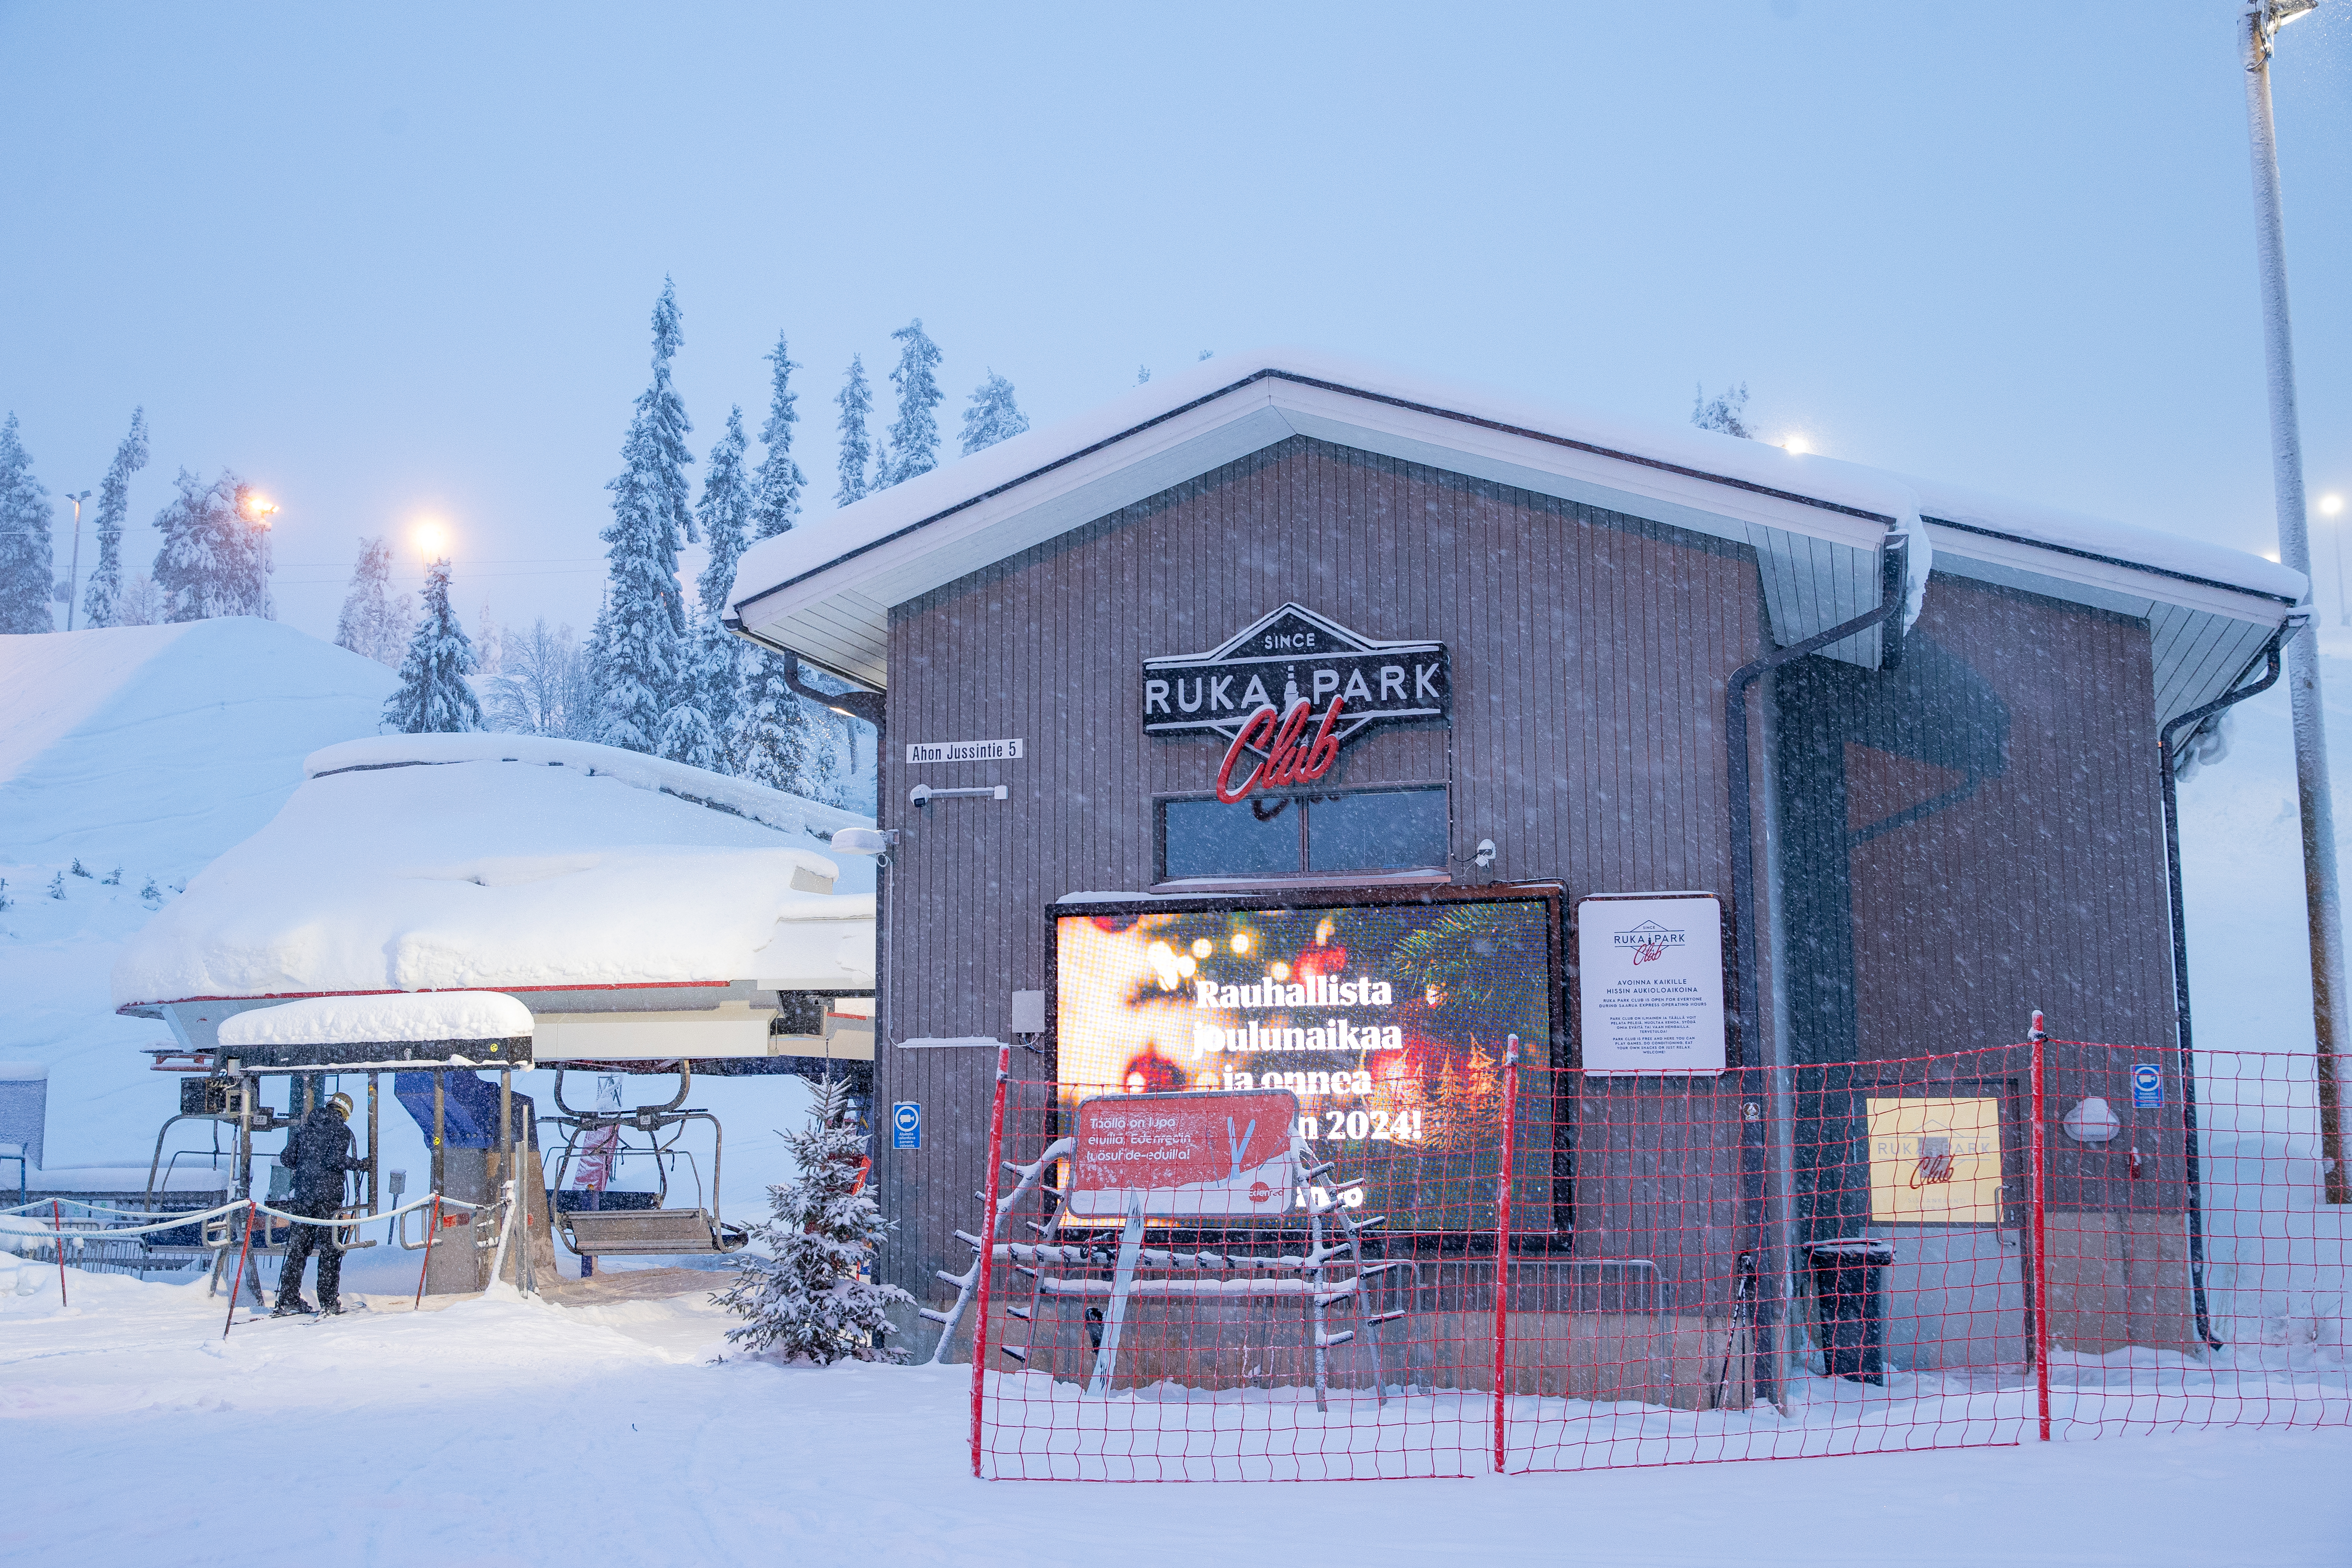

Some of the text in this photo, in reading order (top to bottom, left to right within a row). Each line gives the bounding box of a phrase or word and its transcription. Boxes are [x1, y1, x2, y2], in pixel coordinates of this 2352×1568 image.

[1264, 633, 1315, 649] SINCE
[1146, 663, 1440, 714] RUKA PARK
[912, 741, 1016, 761] Ahon Jussintie 5
[1216, 694, 1344, 804] Club
[1614, 934, 1684, 944] RUKA PARK
[1633, 940, 1663, 966] Club
[1196, 975, 1392, 1008] Rauhallista
[1191, 1019, 1402, 1061] joulunaikaa
[1260, 1071, 1372, 1095] onnea
[1129, 1119, 1145, 1128] on
[1149, 1117, 1176, 1129] lupa
[1326, 1110, 1422, 1140] 2024!
[1131, 1133, 1191, 1144] Edenredin
[1878, 1142, 1991, 1155] RUKA PARK
[1910, 1153, 1955, 1190] Club
